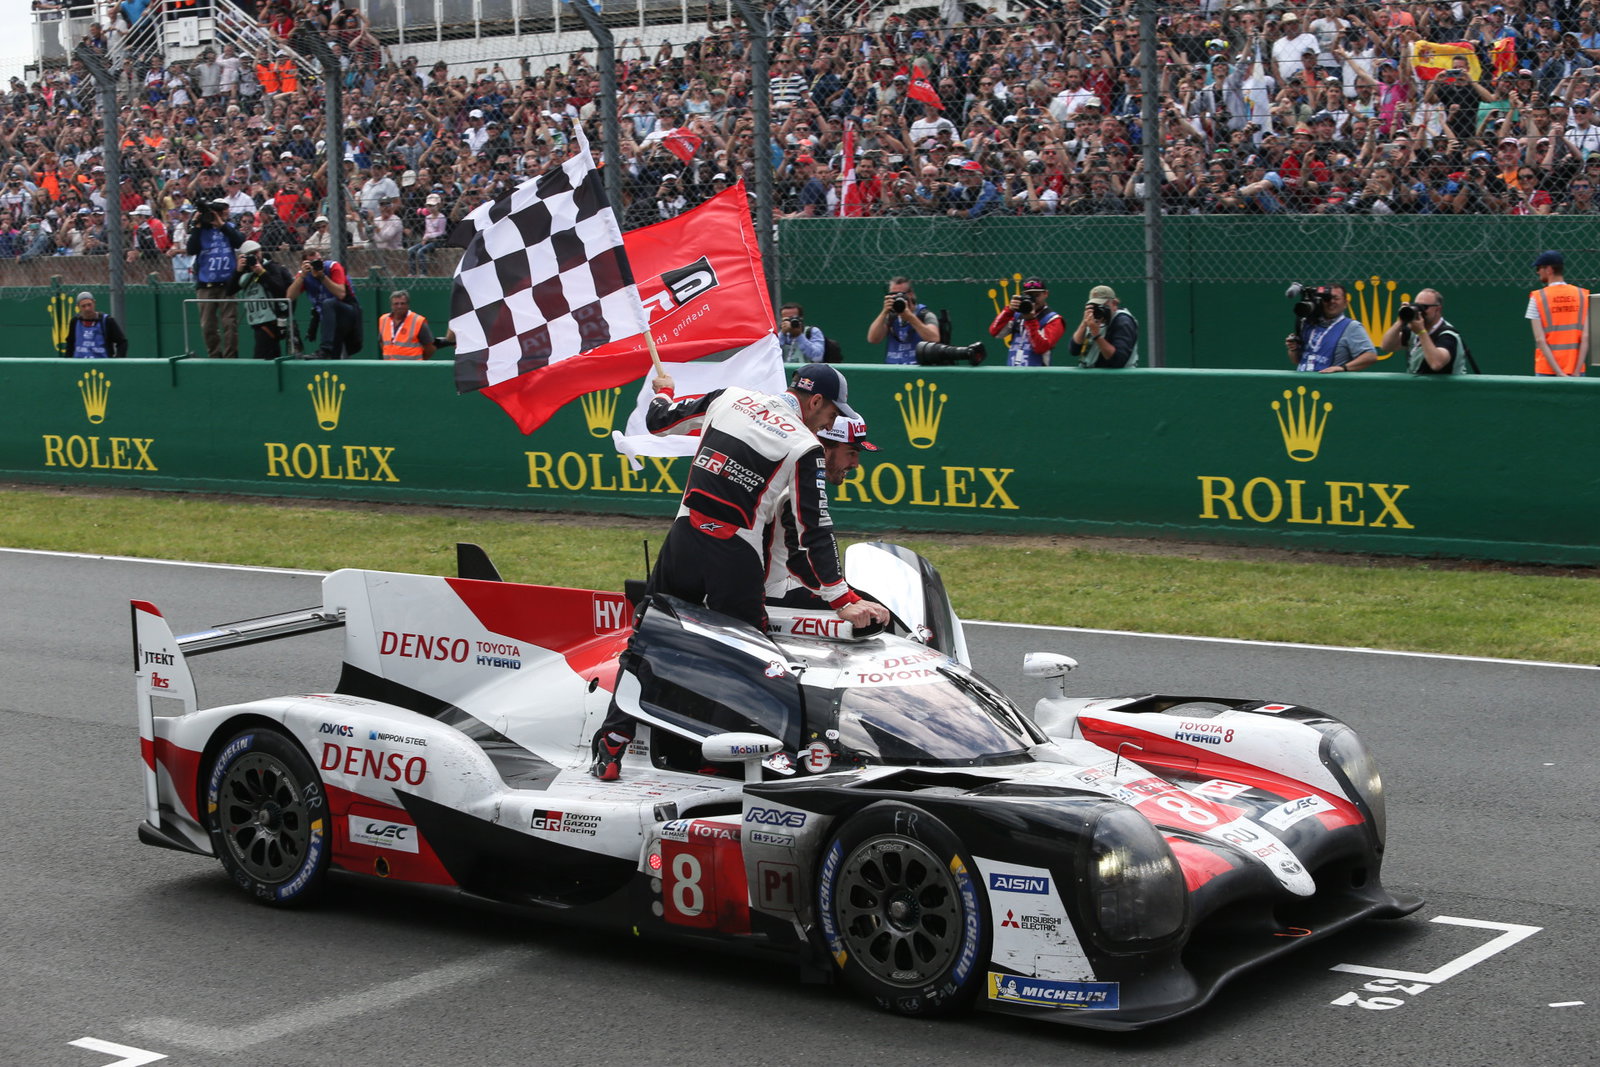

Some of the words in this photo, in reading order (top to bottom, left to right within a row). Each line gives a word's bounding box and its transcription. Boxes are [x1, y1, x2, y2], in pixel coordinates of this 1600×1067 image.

[208, 257, 230, 271] 272
[730, 402, 757, 421] TOYOTA
[737, 396, 797, 433] DENSO
[43, 435, 158, 471] ROLEX
[264, 443, 400, 482] ROLEX
[525, 452, 684, 494] ROLEX
[695, 454, 723, 473] GR
[727, 458, 766, 483] TOYOTA
[724, 465, 759, 487] GAZOO
[834, 462, 1020, 510] ROLEX
[1197, 475, 1415, 529] ROLEX
[595, 600, 624, 629] HY
[790, 616, 845, 637] ZENT
[380, 631, 470, 663] DENSO
[476, 641, 521, 657] TOYOTA
[144, 651, 175, 666] JTEKT
[476, 655, 522, 670] HYBRID
[857, 669, 939, 684] TOYOTA
[319, 722, 354, 738] ADVICS
[1178, 721, 1223, 734] TOYOTA
[1224, 728, 1235, 743] 8
[377, 732, 404, 743] NIPPON
[405, 736, 428, 746] STEEL
[1175, 731, 1222, 745] HYBRID
[731, 745, 758, 755] Mobil
[811, 748, 823, 767] E
[211, 737, 249, 789] MICHELIN
[320, 742, 427, 786] DENSO
[303, 781, 323, 810] RR
[1157, 796, 1218, 825] 8
[1283, 798, 1318, 815] WEC
[531, 817, 561, 832] GR
[564, 812, 602, 822] TOYOTA
[745, 806, 806, 828] RAYS
[894, 810, 919, 840] FR
[365, 823, 408, 840] WEC
[562, 826, 597, 837] Racing
[280, 846, 320, 898] MICHELIN
[672, 853, 704, 916] 8
[764, 869, 794, 904] P1
[820, 848, 839, 936] MICHELIN
[1021, 914, 1062, 926] MITSUBISHI
[1021, 922, 1056, 932] ELECTRIC
[956, 891, 978, 979] MICHELIN
[1022, 985, 1108, 1003] MICHELIN
